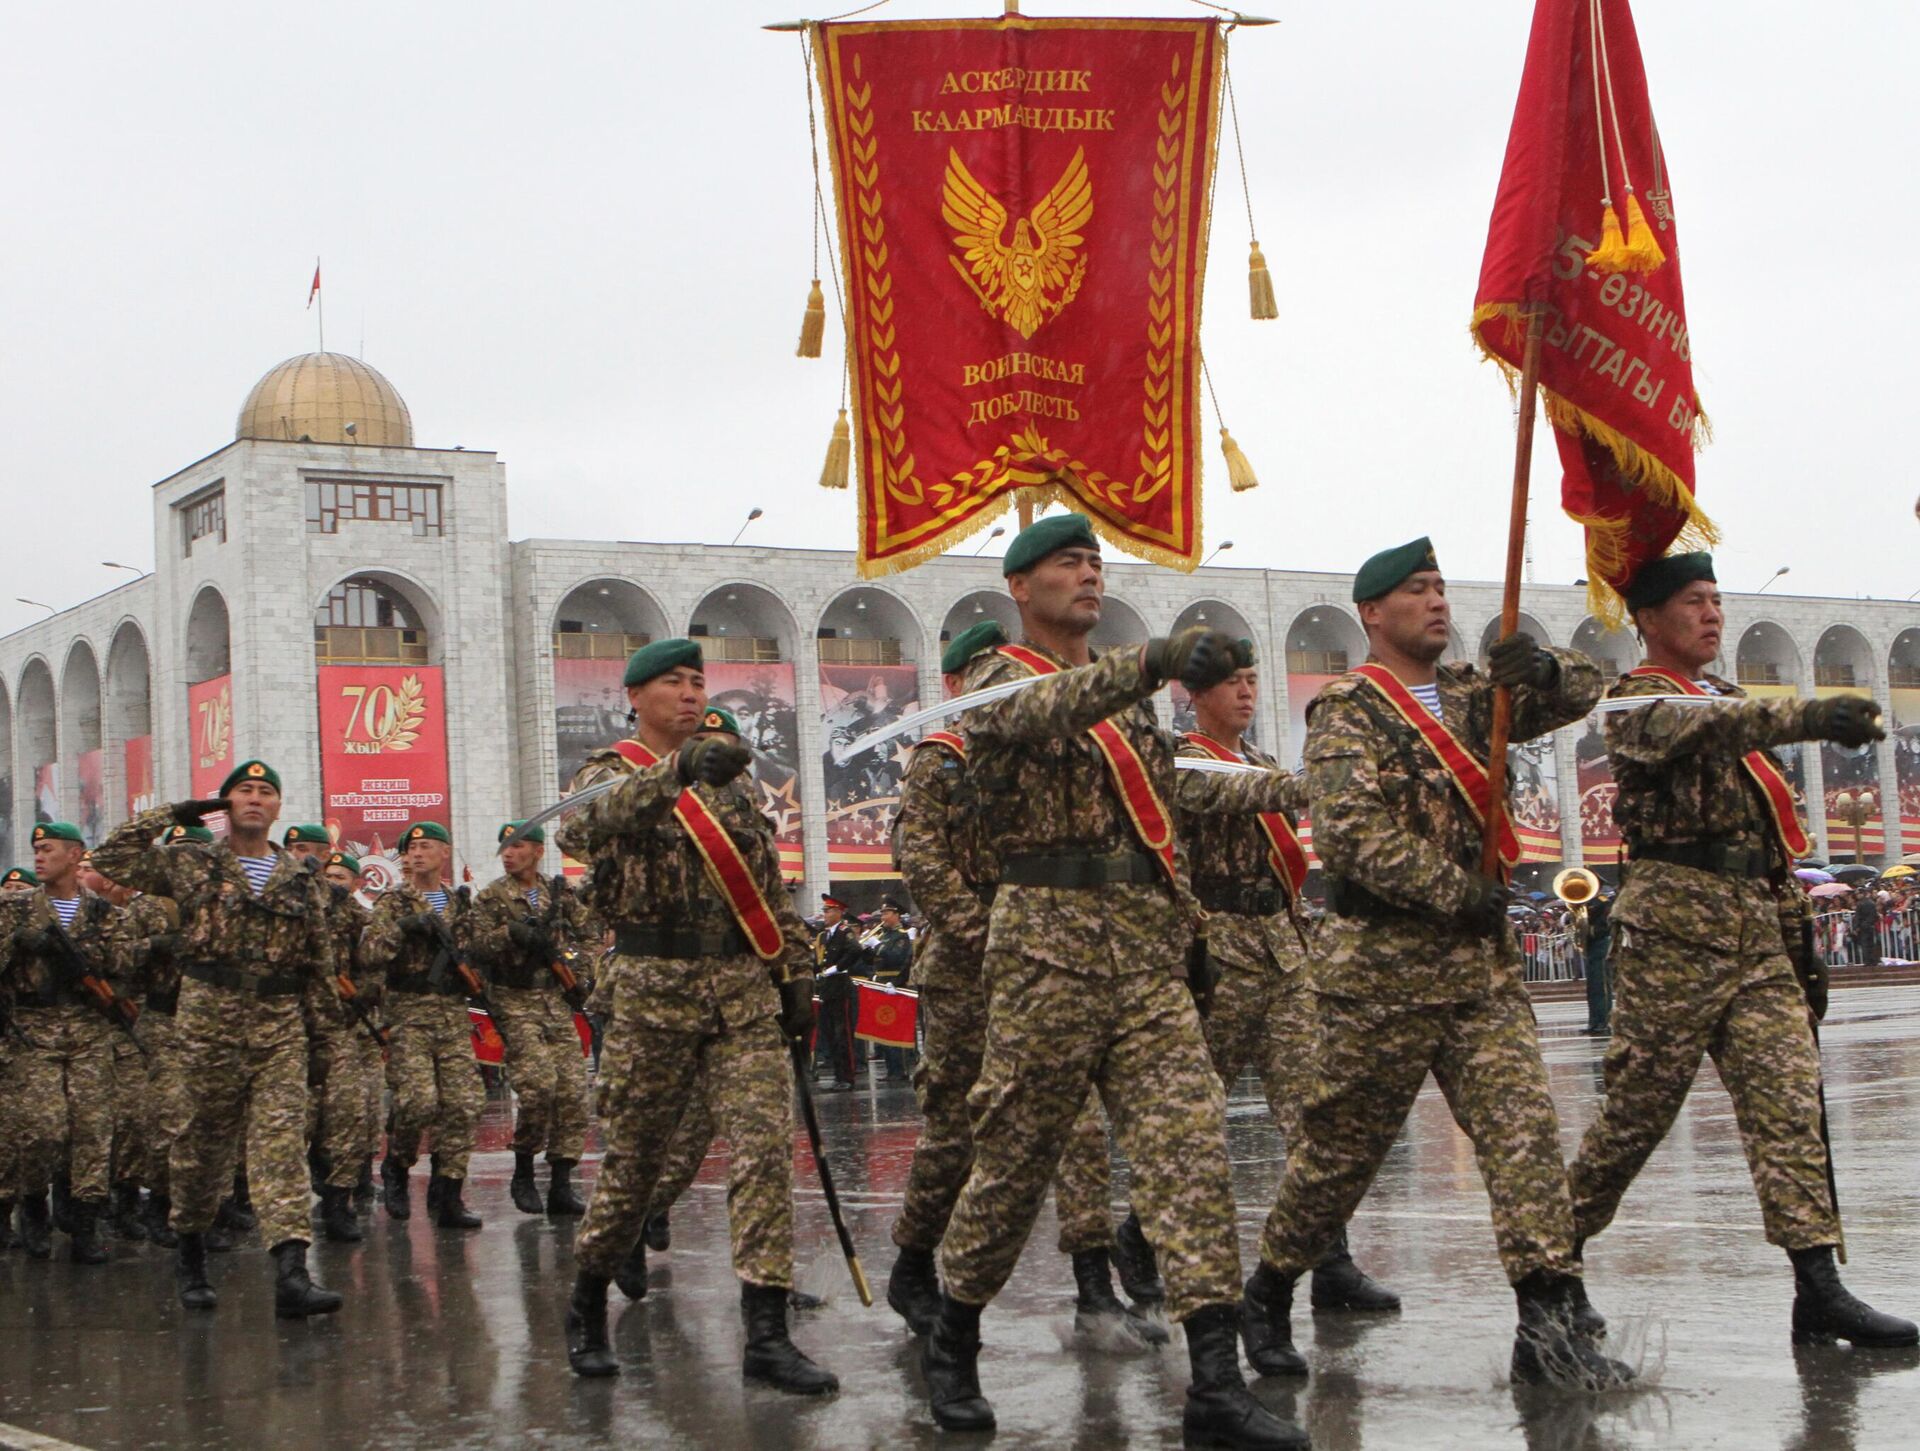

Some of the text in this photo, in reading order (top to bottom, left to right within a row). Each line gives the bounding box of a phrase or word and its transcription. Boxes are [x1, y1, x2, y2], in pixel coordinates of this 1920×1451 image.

[939, 68, 1092, 96] АСКЕРДИК
[911, 104, 1116, 133] КААРМАНДЫК
[962, 352, 1086, 386] ВОИНСКАЯ
[967, 390, 1080, 428] ДОБЛЕСТЬ
[199, 698, 220, 754] 70
[341, 685, 396, 740] 70
[343, 741, 382, 754] ЖЫЛ
[363, 809, 410, 822] МЕНЕН!
